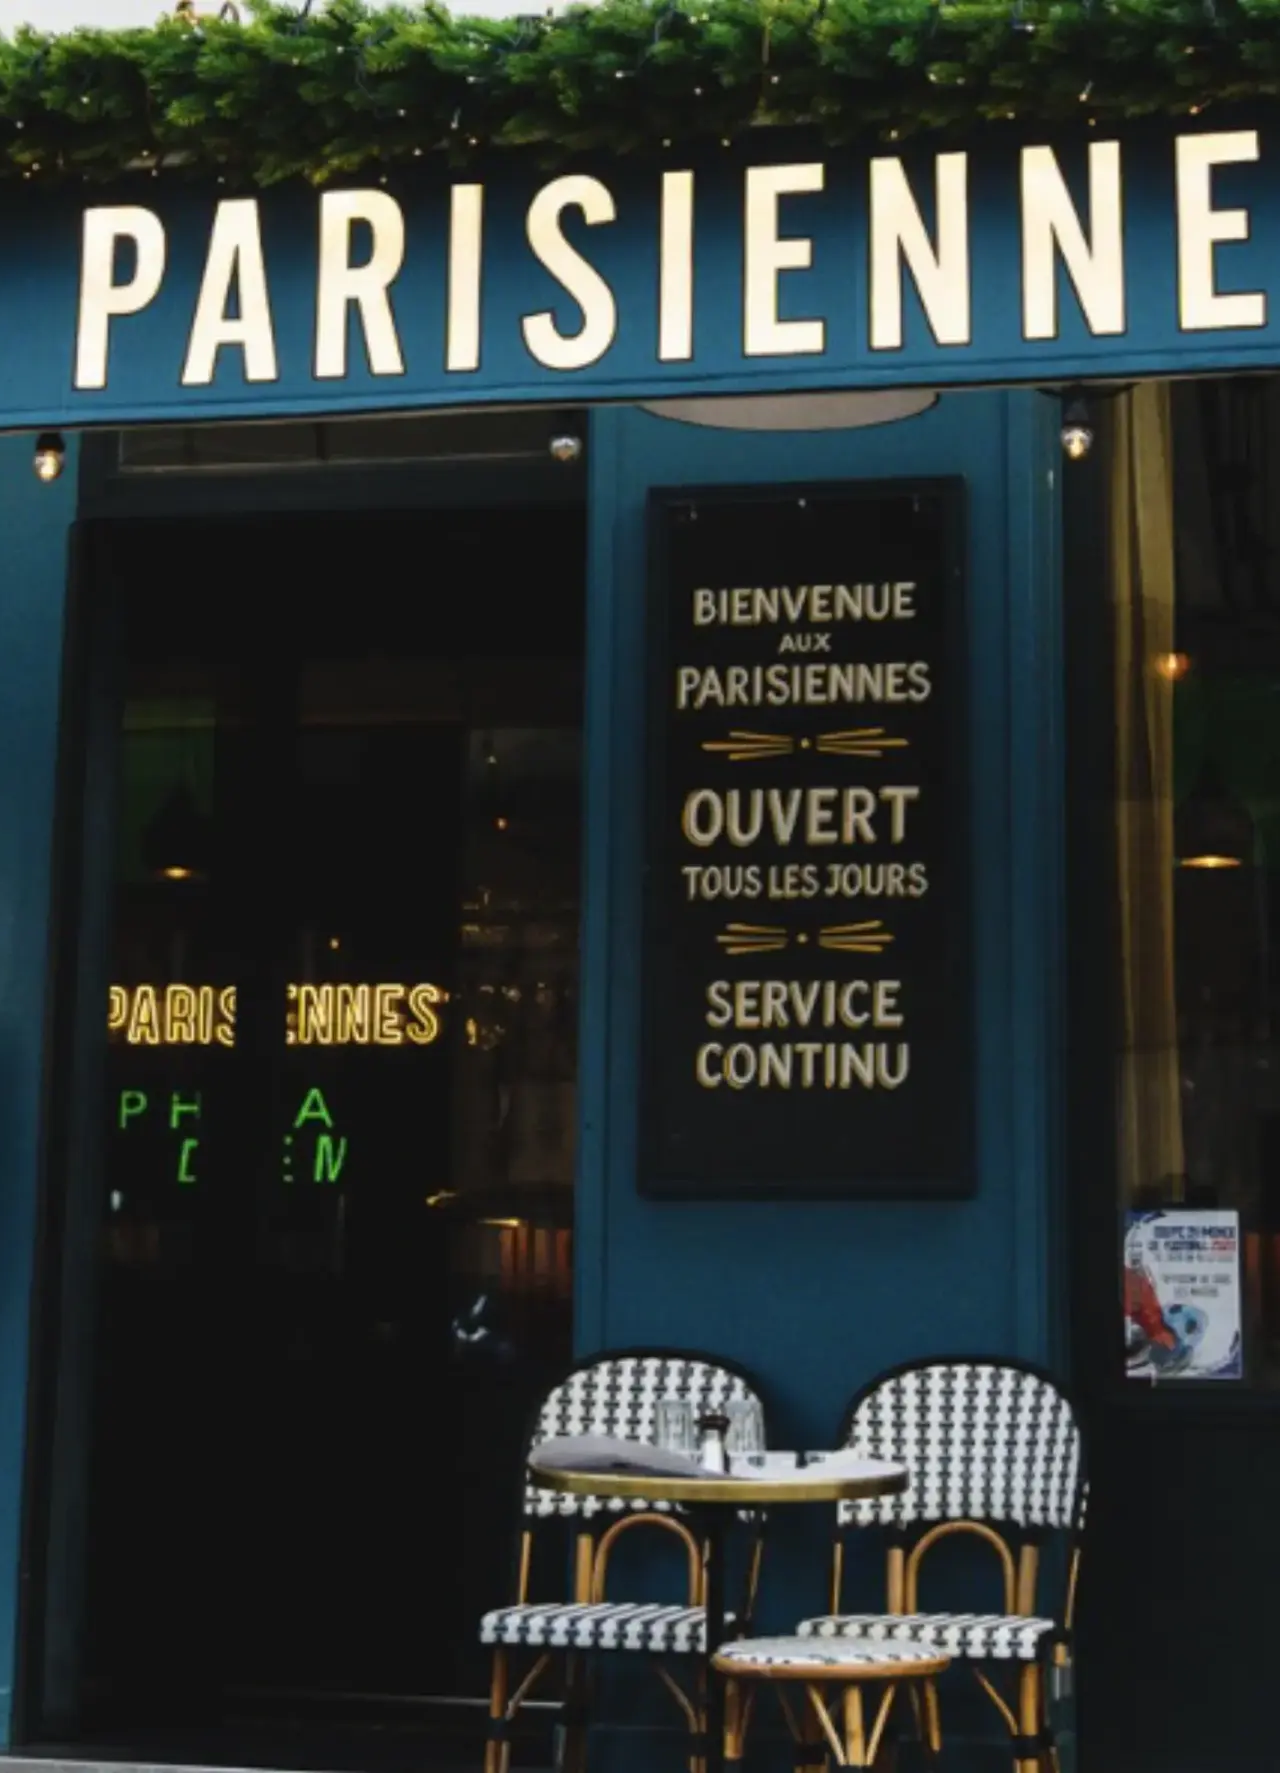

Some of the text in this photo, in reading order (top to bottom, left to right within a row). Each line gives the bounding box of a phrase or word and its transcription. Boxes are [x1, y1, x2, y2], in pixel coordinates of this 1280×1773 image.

[693, 582, 917, 625] BIENVENUE
[778, 633, 831, 653] AUX
[677, 661, 932, 709] PARISIENNES
[682, 785, 920, 847] OUVERT
[681, 862, 929, 900] TOUS LES JOURS
[705, 978, 904, 1029] SERVICE
[695, 1041, 910, 1090] CONTINU
